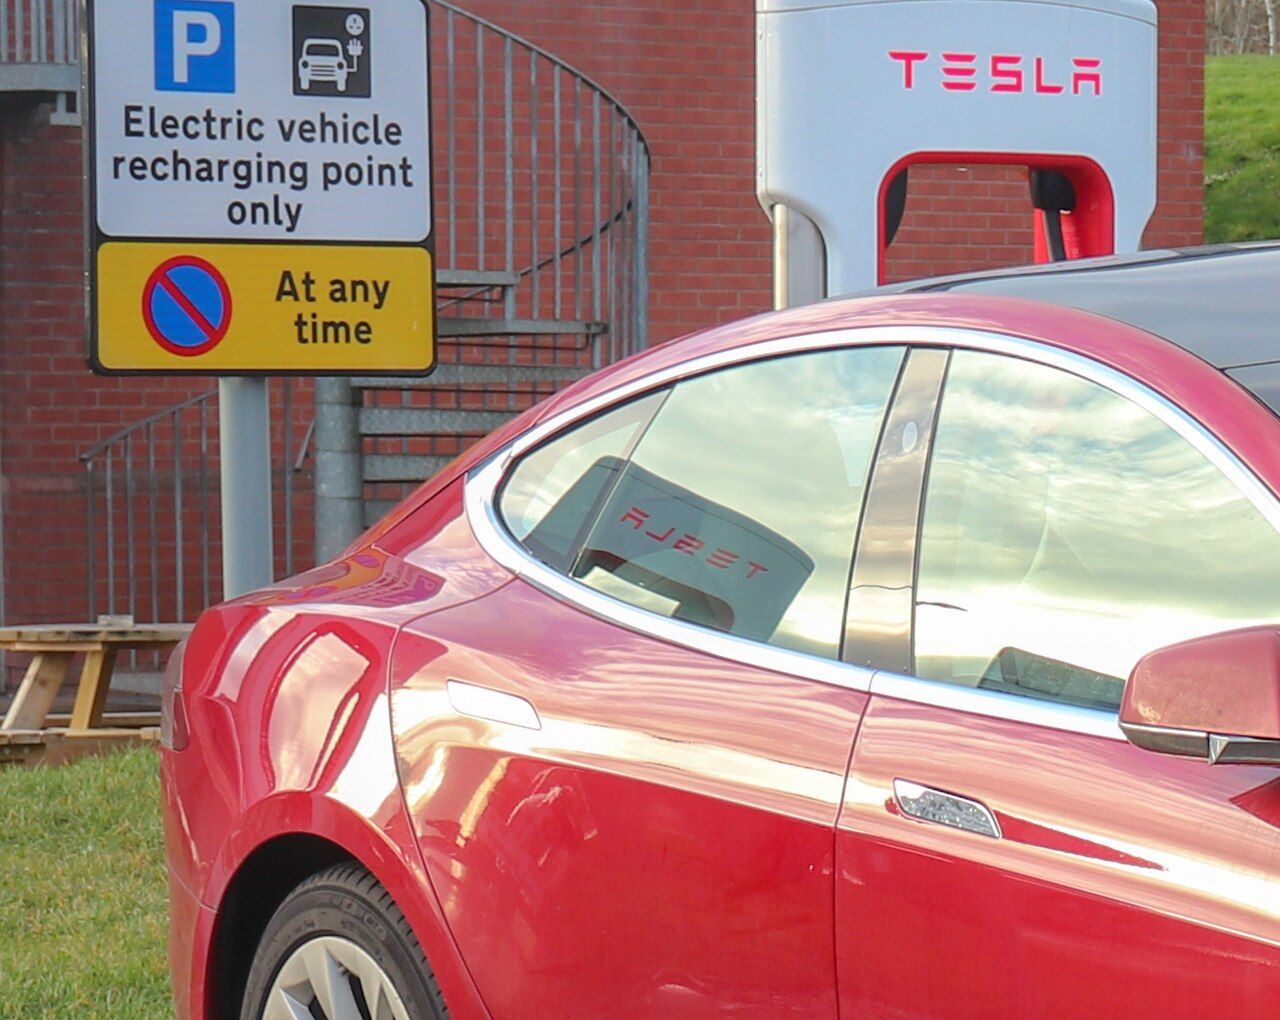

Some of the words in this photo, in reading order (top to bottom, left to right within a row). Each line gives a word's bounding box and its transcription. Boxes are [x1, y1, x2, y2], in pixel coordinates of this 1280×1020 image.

[172, 9, 221, 83] P
[888, 50, 1102, 96] TESLA
[123, 105, 265, 142] Electric
[278, 112, 403, 146] vehicle
[112, 149, 308, 191] recharging
[322, 155, 414, 191] point
[227, 194, 303, 232] only
[275, 270, 316, 303] At
[329, 278, 391, 310] any
[294, 312, 373, 345] time
